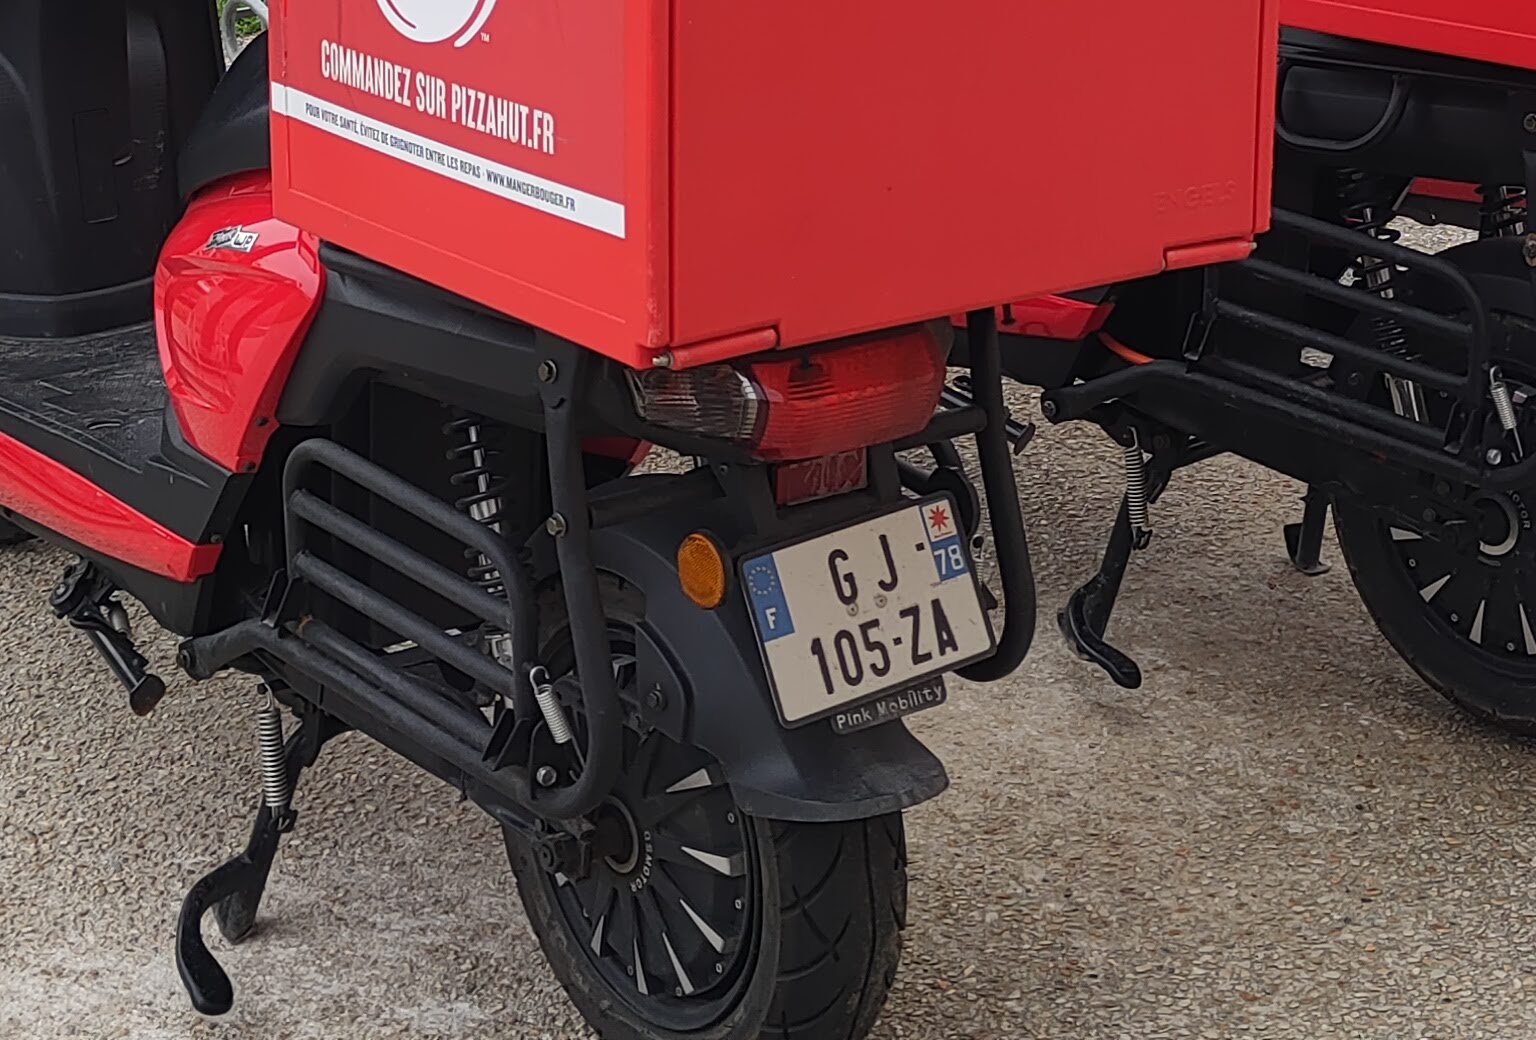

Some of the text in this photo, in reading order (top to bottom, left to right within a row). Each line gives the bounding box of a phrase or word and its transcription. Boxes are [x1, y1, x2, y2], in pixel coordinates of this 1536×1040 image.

[320, 39, 555, 155] COMMANDEZ SUR PIZZAHUT.FR
[305, 102, 320, 119] POUR
[321, 108, 339, 127] VOTRE
[360, 121, 380, 142] ÉVITEZ
[381, 131, 389, 146] DE
[390, 135, 424, 158] GRIGNOTER
[425, 147, 446, 166] ENTRE
[446, 155, 458, 171] LES
[460, 160, 481, 179] REPAS
[486, 168, 576, 211] WWW.MANGERBOUGER.FR
[934, 544, 964, 575] 78
[765, 607, 777, 630] F
[810, 598, 958, 695] 105-ZA
[836, 685, 942, 729] Pink Mobility
